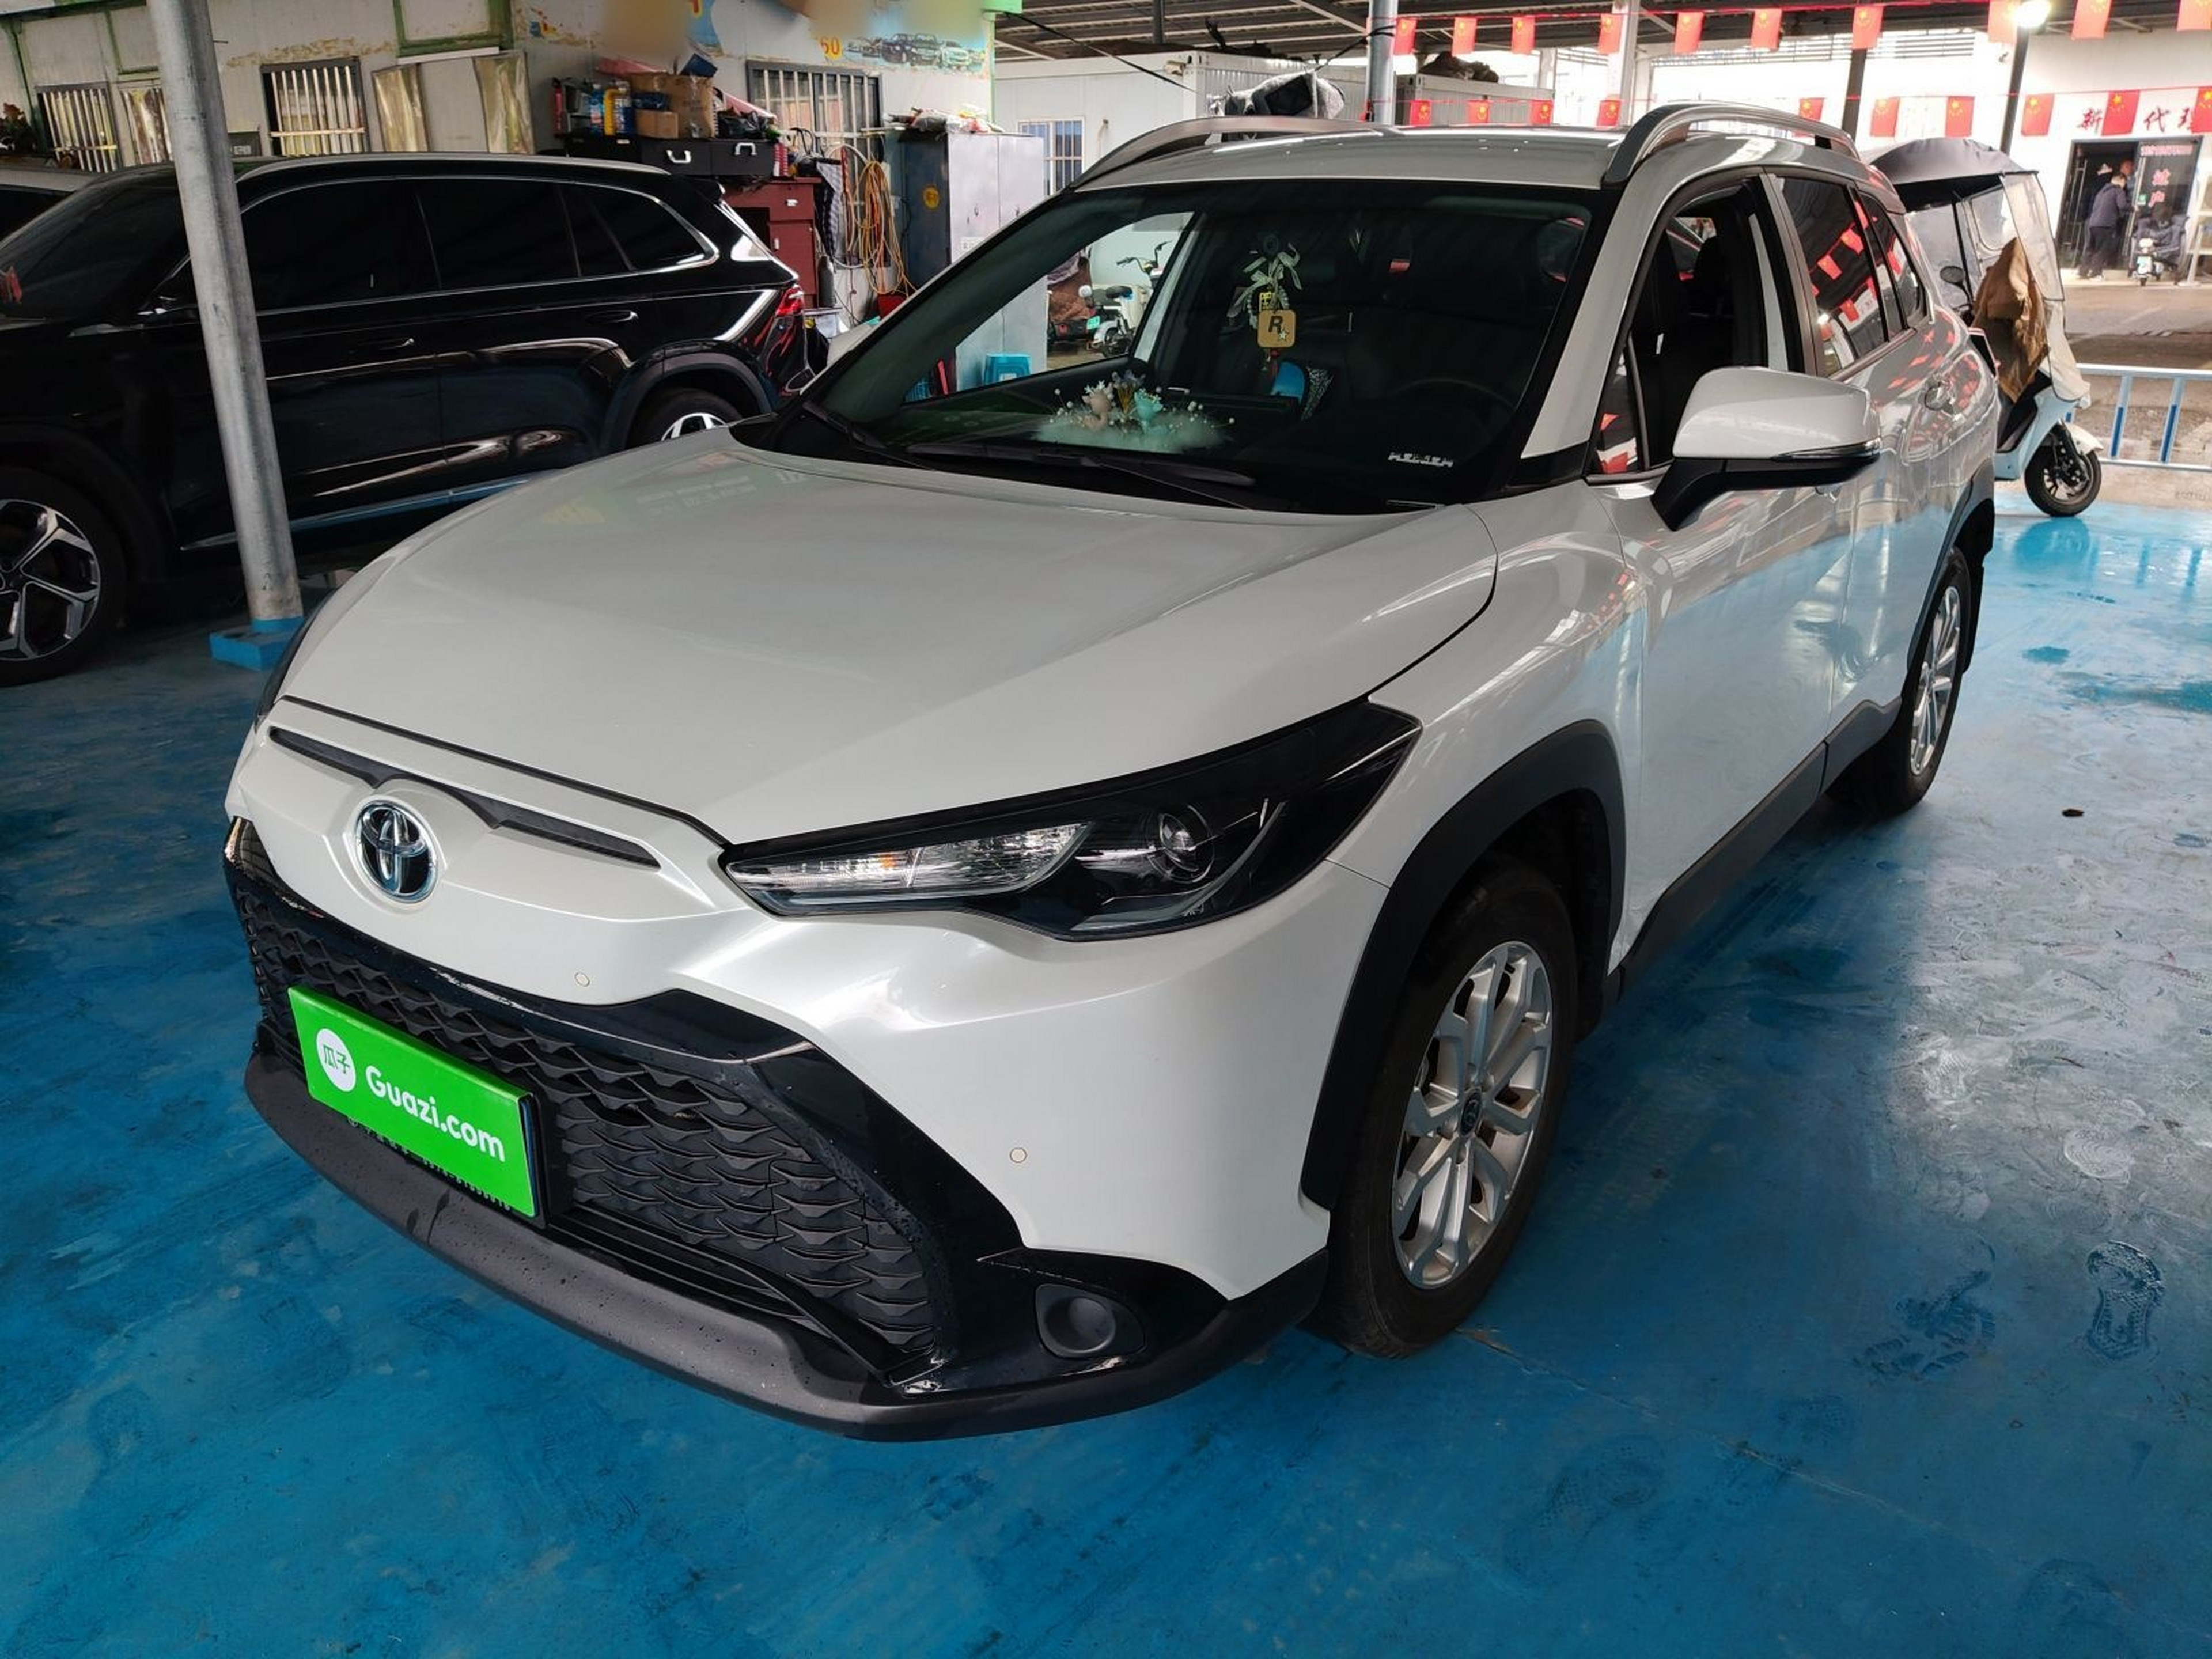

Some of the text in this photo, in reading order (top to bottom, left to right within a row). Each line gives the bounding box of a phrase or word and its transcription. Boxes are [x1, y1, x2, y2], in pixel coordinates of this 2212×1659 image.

[1268, 315, 1283, 334] R
[323, 1044, 350, 1075] 瓜子
[365, 1065, 505, 1162] Guazi.com
